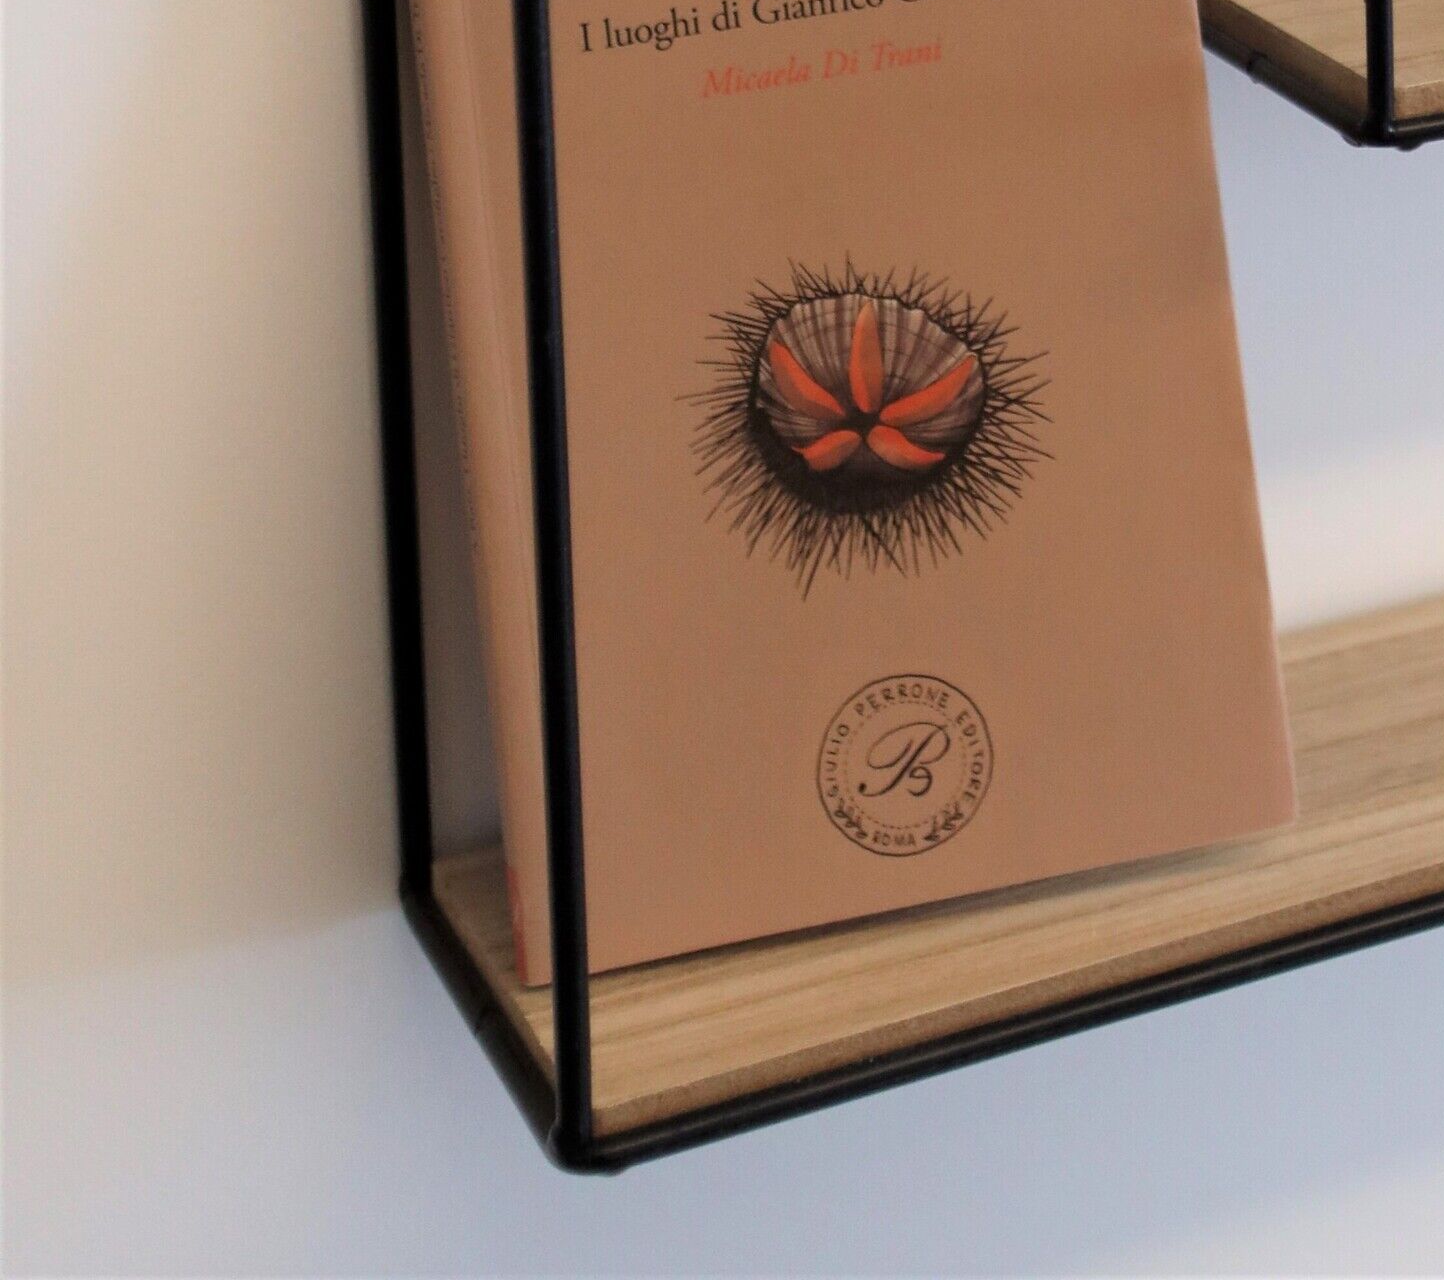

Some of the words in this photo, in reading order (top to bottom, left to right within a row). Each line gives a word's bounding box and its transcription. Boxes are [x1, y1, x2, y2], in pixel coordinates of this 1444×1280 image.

[579, 21, 594, 52] I
[603, 7, 700, 51] luoghi
[712, 0, 741, 32] di
[701, 56, 811, 98] Micaela
[823, 49, 859, 80] Di
[870, 36, 943, 72] Trani
[825, 723, 850, 798] GIULIO
[853, 683, 950, 716] PERRONE
[955, 710, 984, 800] EDITORE
[872, 830, 917, 847] ROMA
